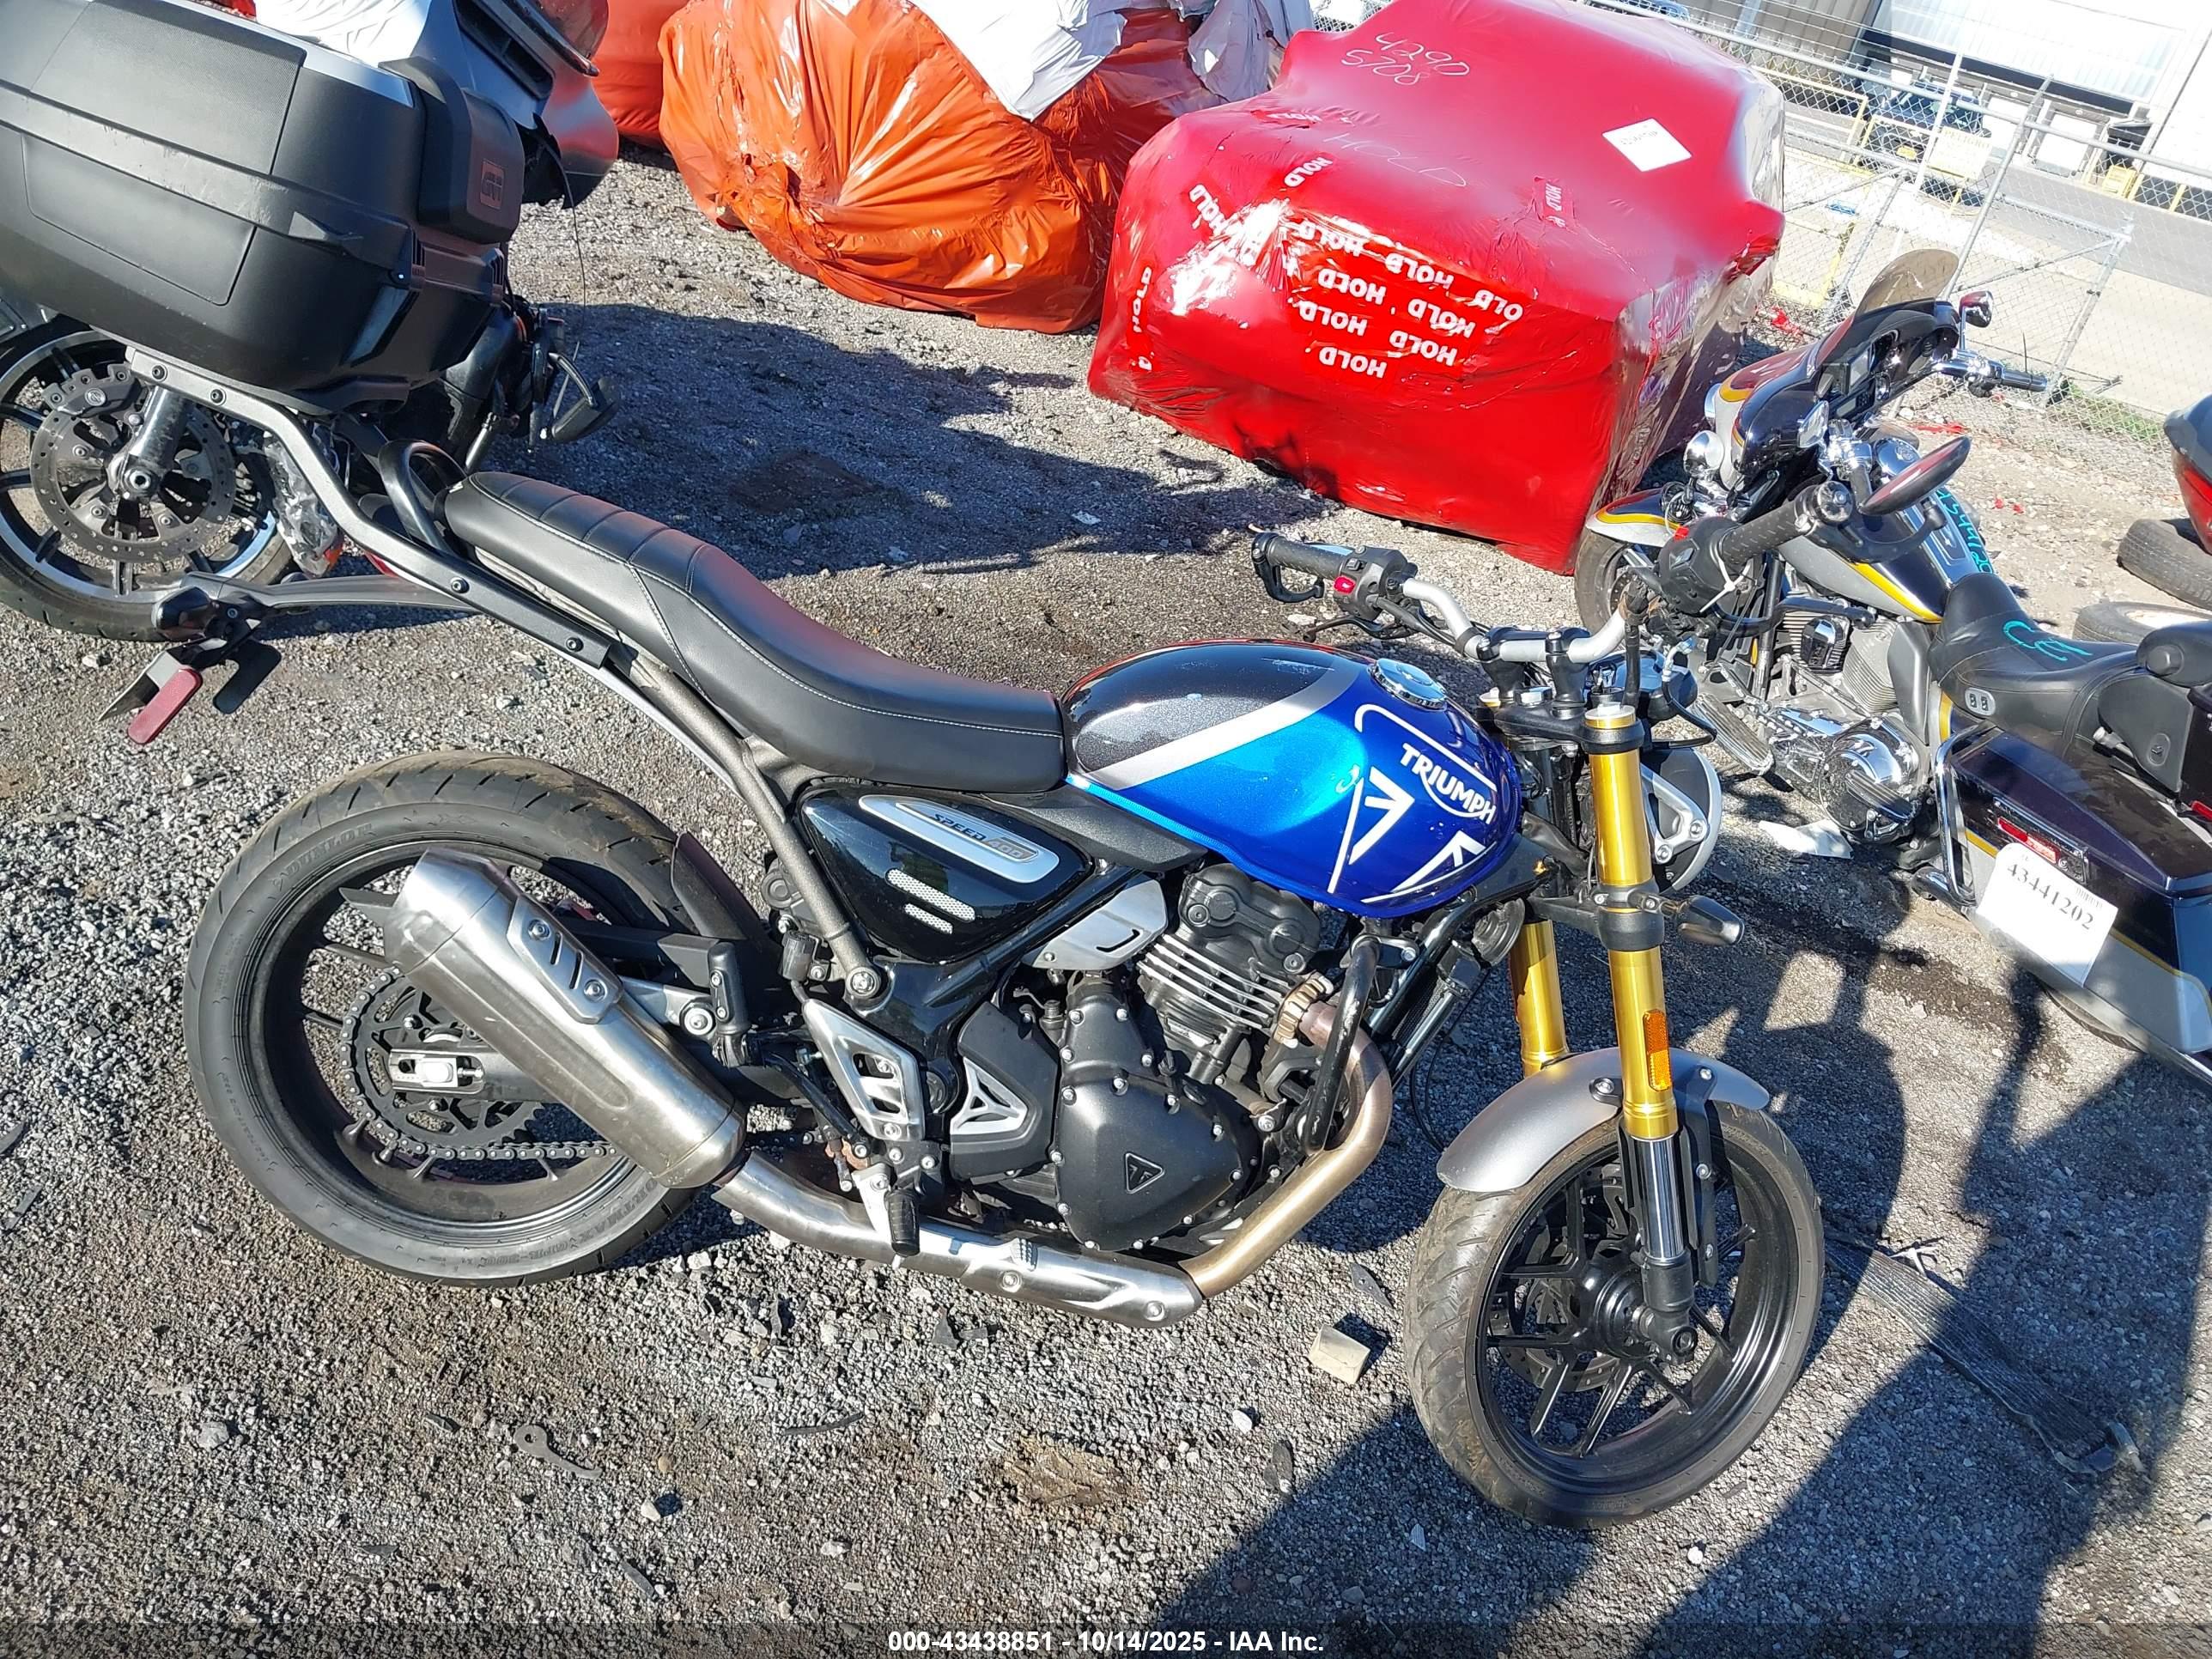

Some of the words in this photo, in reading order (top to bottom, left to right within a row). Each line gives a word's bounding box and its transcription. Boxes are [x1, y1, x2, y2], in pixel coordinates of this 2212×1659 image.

[1341, 49, 1431, 85] 5708
[1376, 32, 1470, 76] 4290
[1284, 156, 1333, 187] HOLD
[1323, 133, 1467, 186] HOLD
[1546, 182, 1563, 211] HOLD
[1297, 220, 1366, 257] HOLD
[1317, 268, 1388, 306] HOLD
[1384, 252, 1455, 290] HOLD
[1131, 266, 1152, 333] HOLD
[1407, 298, 1477, 338] HOLD
[1471, 289, 1524, 322] OLD
[1297, 301, 1368, 337] HOLD
[1318, 346, 1388, 379] HOLD
[1389, 330, 1458, 367] HOLD
[1397, 742, 1498, 825] TRIUMPH
[933, 812, 988, 842] SPEED
[987, 839, 1025, 859] 400
[2006, 861, 2095, 930] 43441202
[579, 1179, 658, 1243] ORTMAX
